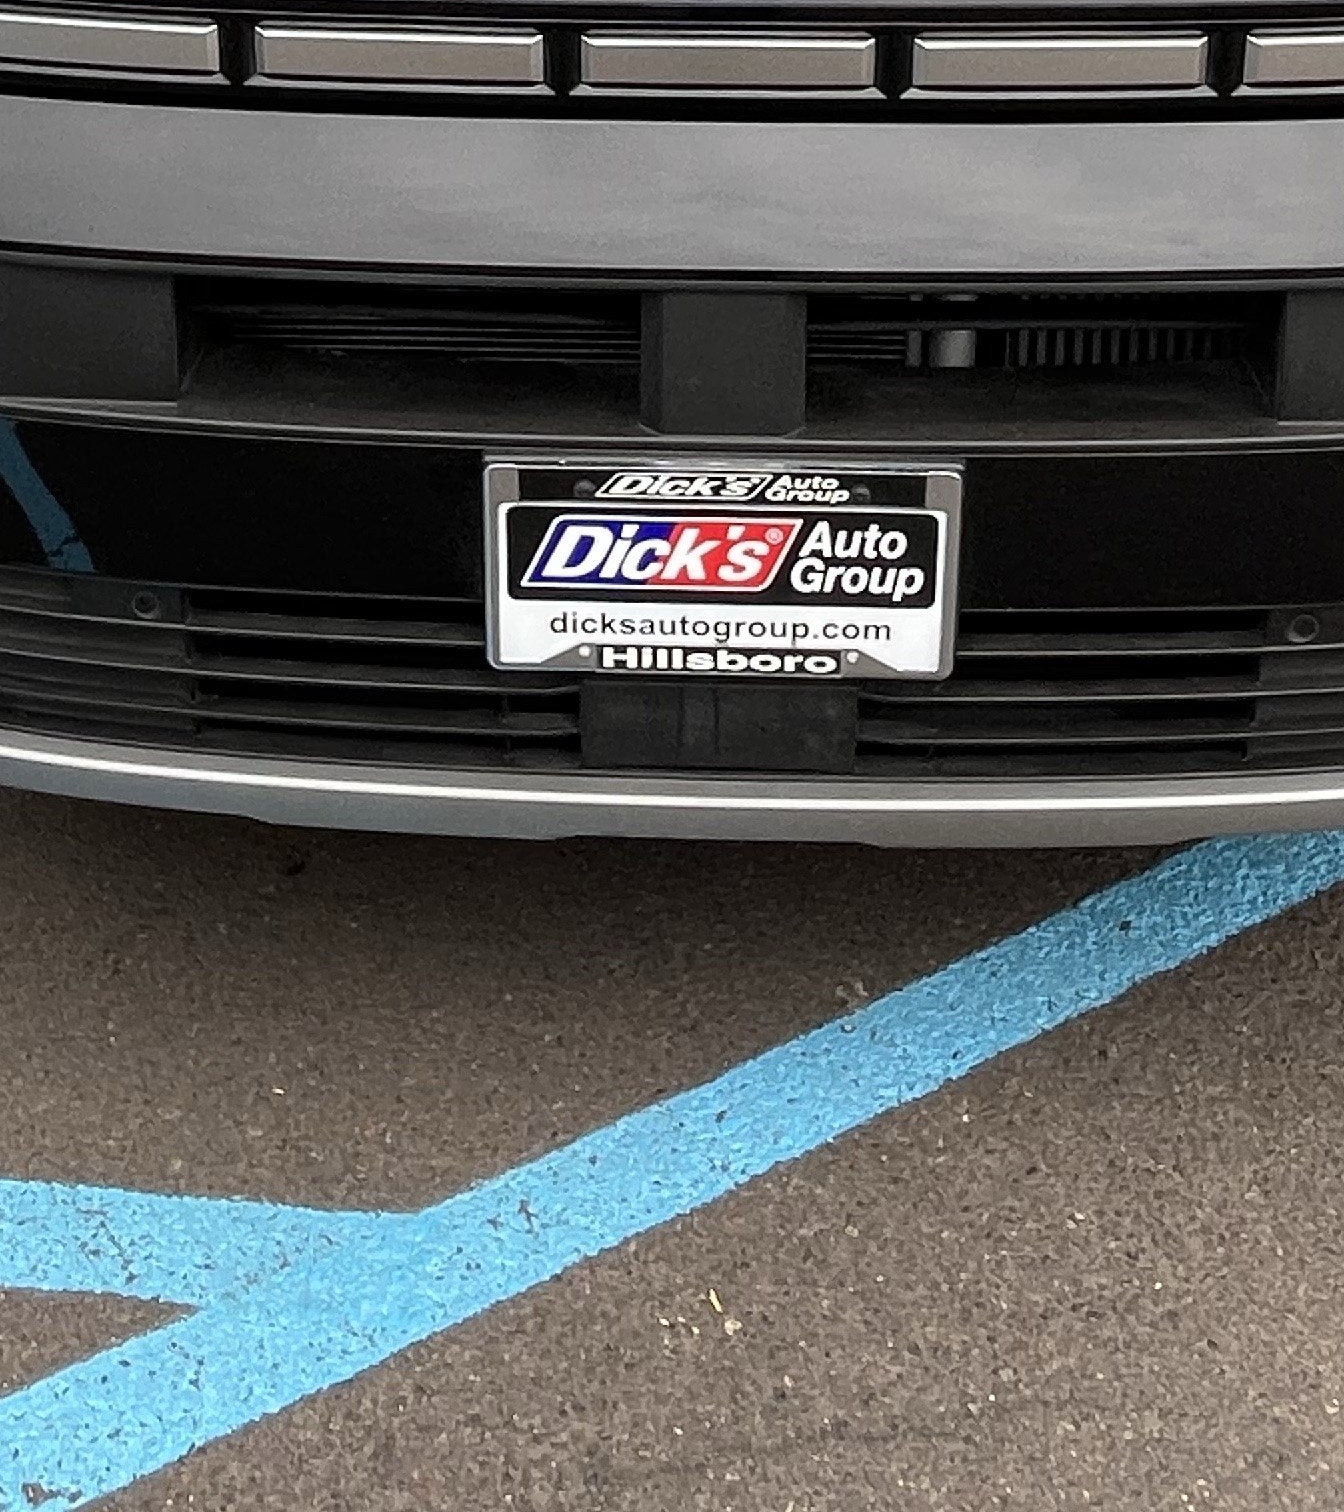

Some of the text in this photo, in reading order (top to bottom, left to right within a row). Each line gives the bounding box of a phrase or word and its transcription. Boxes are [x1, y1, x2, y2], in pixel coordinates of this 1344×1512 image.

[764, 488, 850, 505] Group
[771, 474, 840, 491] Auto
[541, 524, 767, 583] Dick's
[799, 520, 908, 561] Auto
[790, 557, 925, 602] Group
[549, 612, 892, 645] dicksautogroup.com
[601, 647, 838, 674] Hillsboro
